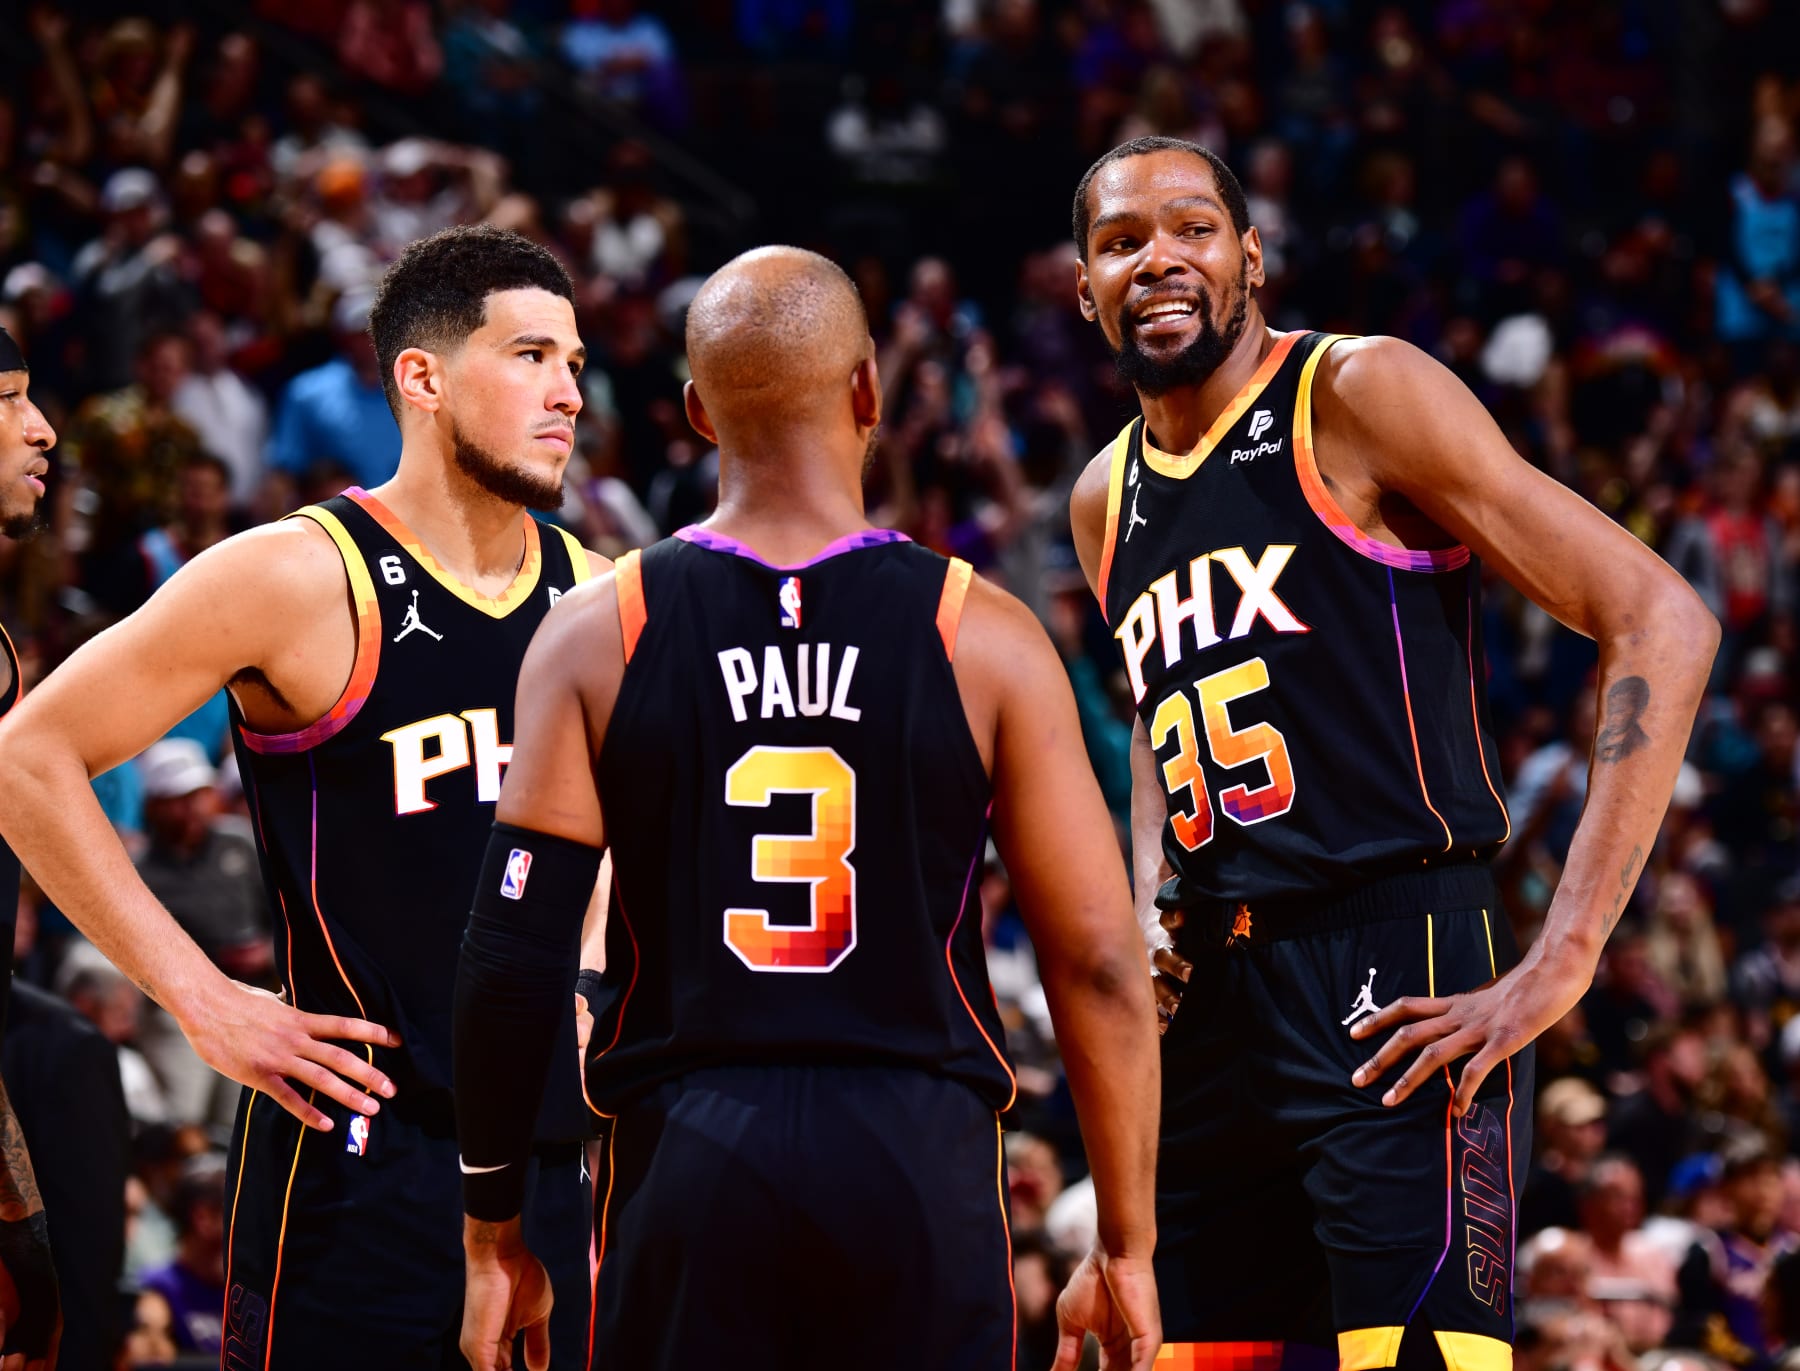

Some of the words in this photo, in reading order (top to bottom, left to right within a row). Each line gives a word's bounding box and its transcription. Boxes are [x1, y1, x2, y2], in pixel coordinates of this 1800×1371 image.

[1230, 437, 1283, 465] PayPal
[379, 555, 407, 585] 6
[1113, 544, 1313, 707] PHX
[717, 642, 862, 723] PAUL
[1150, 656, 1296, 852] 35
[723, 745, 858, 974] 3
